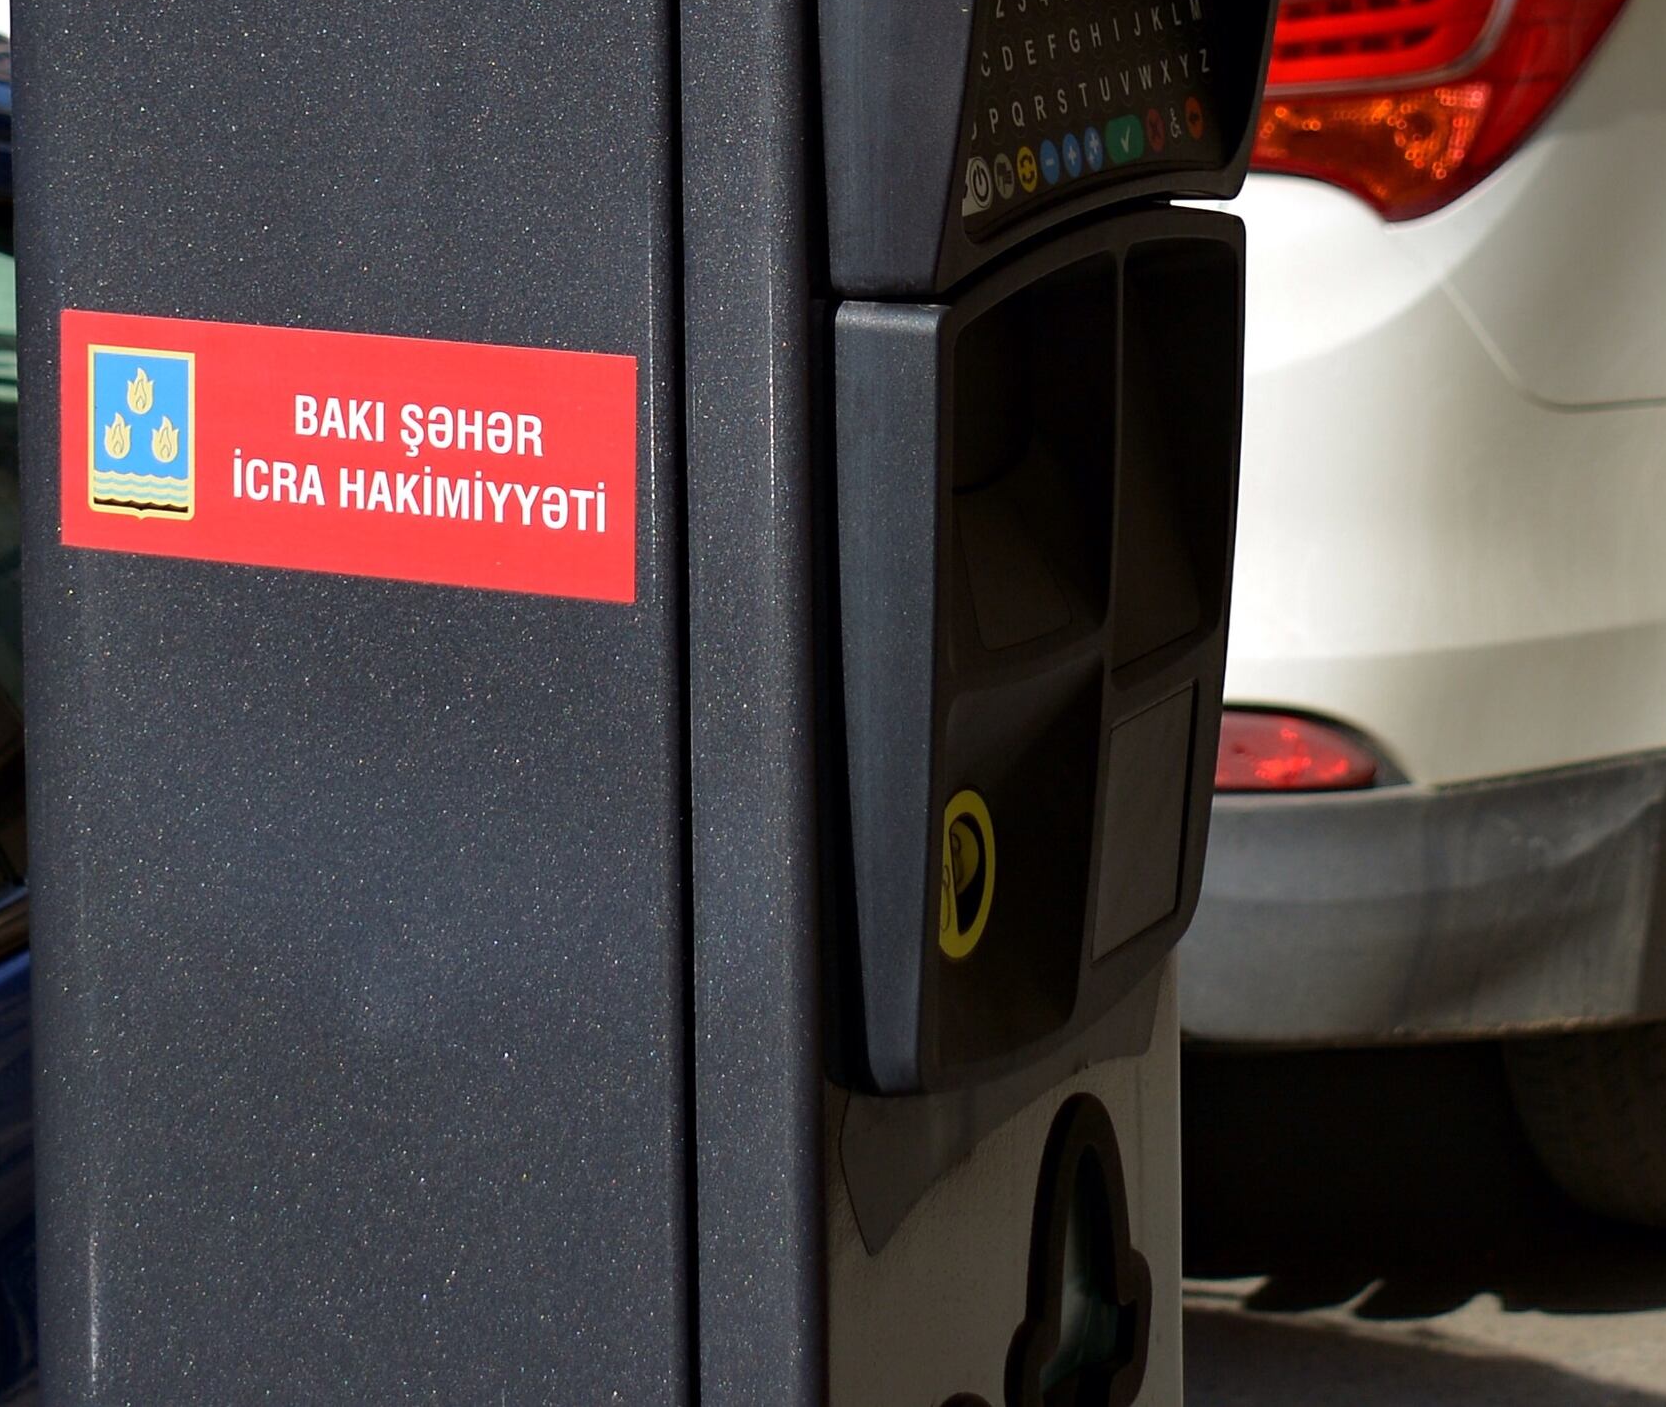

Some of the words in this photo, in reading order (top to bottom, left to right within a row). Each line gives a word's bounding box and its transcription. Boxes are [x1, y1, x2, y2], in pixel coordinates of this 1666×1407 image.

[1002, 45, 1013, 71] D
[1025, 39, 1036, 65] E
[1047, 34, 1056, 59] F
[1069, 28, 1080, 53] G
[1090, 23, 1102, 47] H
[1113, 18, 1120, 41] I
[1134, 12, 1141, 36] J
[1151, 7, 1162, 30] K
[1172, 2, 1182, 25] L
[989, 107, 998, 134] P
[1012, 101, 1025, 127] Q
[1035, 95, 1047, 121] R
[1057, 89, 1068, 114] S
[1079, 82, 1088, 107] T
[1100, 77, 1111, 102] U
[1120, 71, 1130, 95] V
[1138, 65, 1152, 90] W
[1160, 60, 1171, 84] X
[1179, 54, 1189, 78] Y
[1199, 49, 1210, 73] Z
[295, 394, 385, 443] BAKI
[400, 403, 544, 457] ŞƏHƏR
[233, 448, 326, 506] İCRA
[340, 465, 606, 533] HAKİMİYYƏTİ
